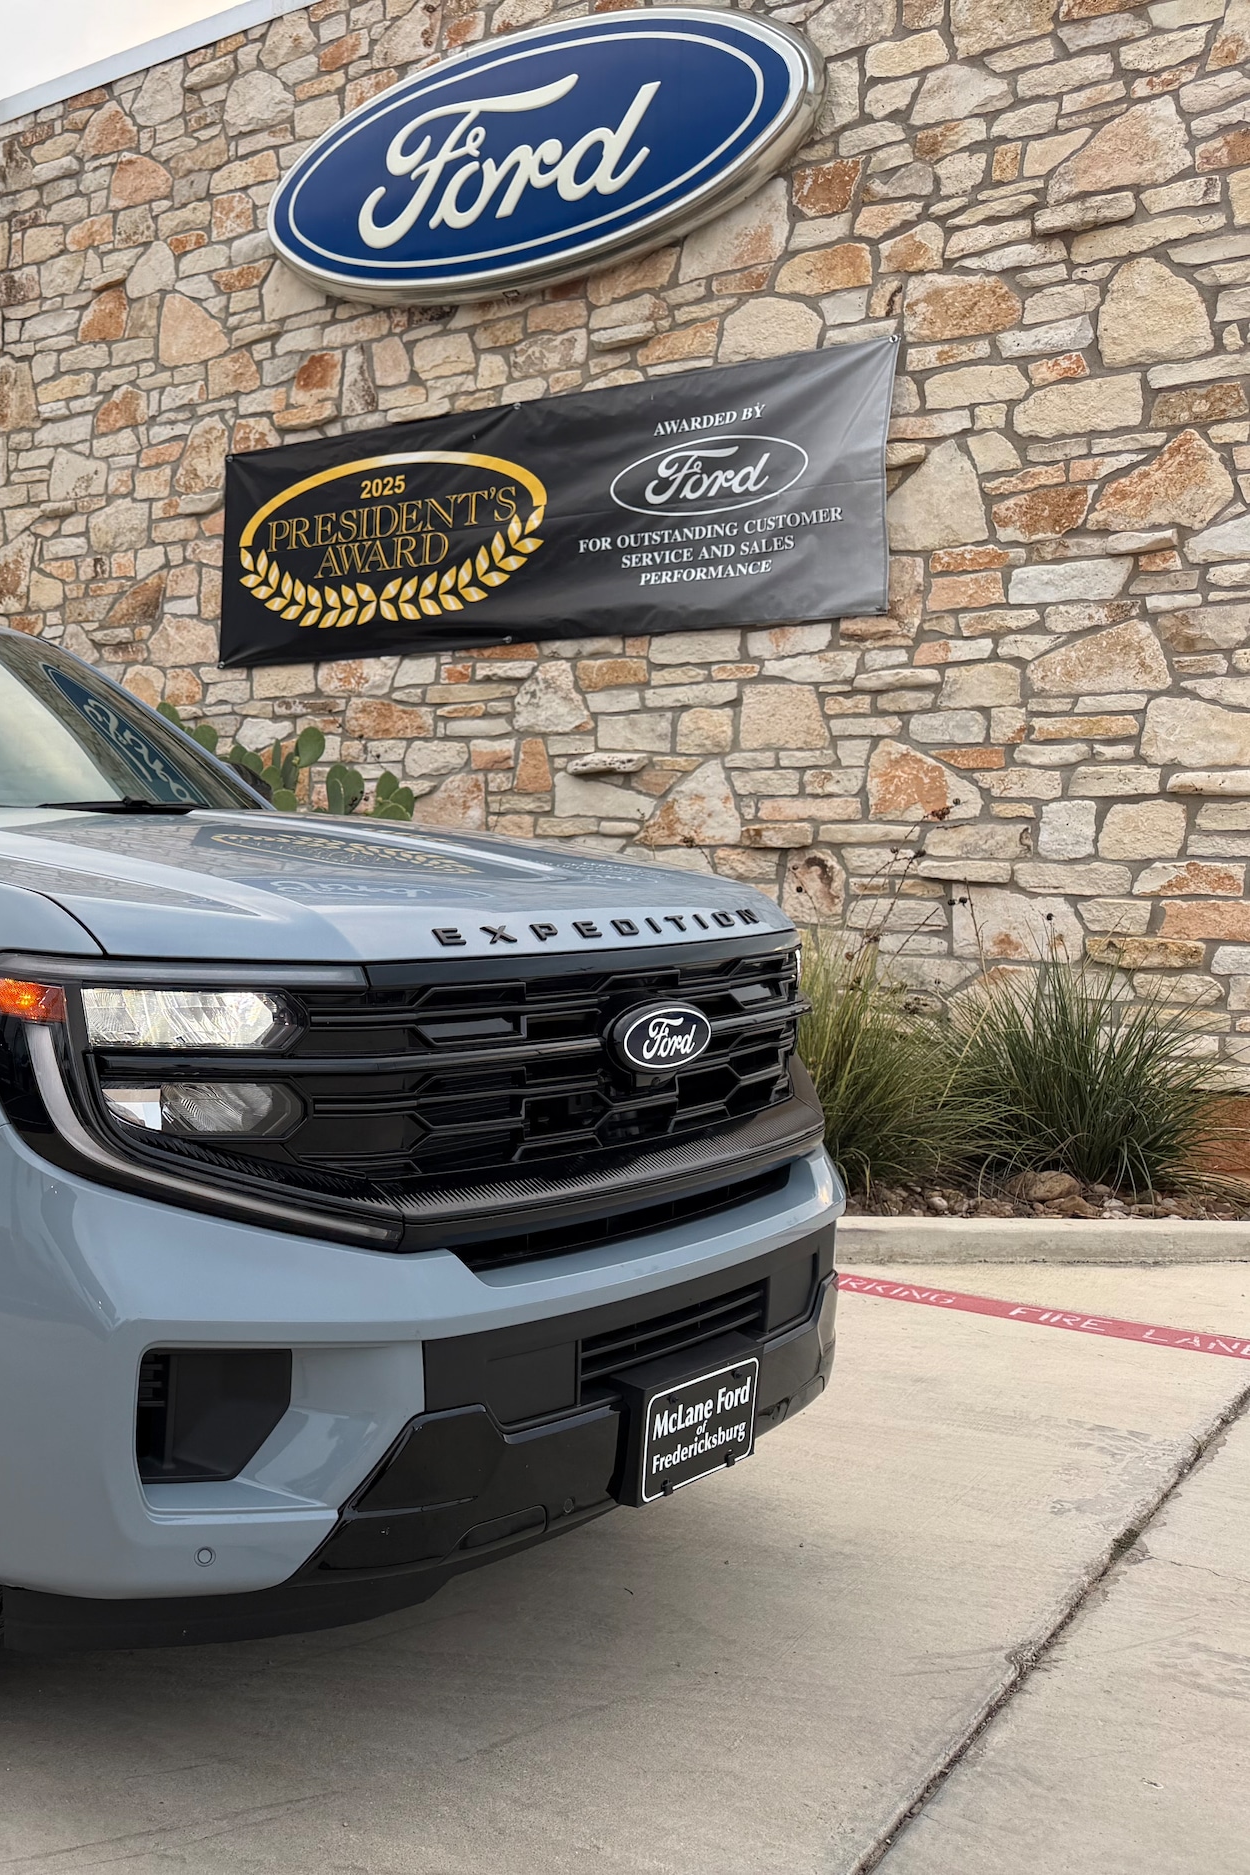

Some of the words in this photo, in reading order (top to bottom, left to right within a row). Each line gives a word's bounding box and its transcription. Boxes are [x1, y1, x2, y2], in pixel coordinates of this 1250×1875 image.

[358, 73, 661, 250] Ford
[653, 410, 737, 437] AWARDED
[742, 404, 766, 420] BY
[360, 475, 406, 499] 2025
[645, 446, 770, 505] Ford
[267, 486, 517, 553] PRESIDENT'S
[578, 537, 612, 554] FOR
[617, 522, 739, 549] OUTSTANDING
[744, 506, 843, 535] CUSTOMER
[313, 532, 449, 579] AWARD
[621, 548, 694, 569] SERVICE
[698, 541, 736, 561] AND
[740, 535, 795, 556] SALES
[639, 559, 772, 586] PERFORMANCE
[431, 908, 761, 946] EXPEDITION
[642, 1016, 697, 1060] Ford
[1008, 1306, 1113, 1332] FIRE
[653, 1399, 714, 1441] McLane
[716, 1376, 751, 1414] Ford
[696, 1420, 707, 1435] of
[652, 1422, 746, 1474] Fredericksburg
